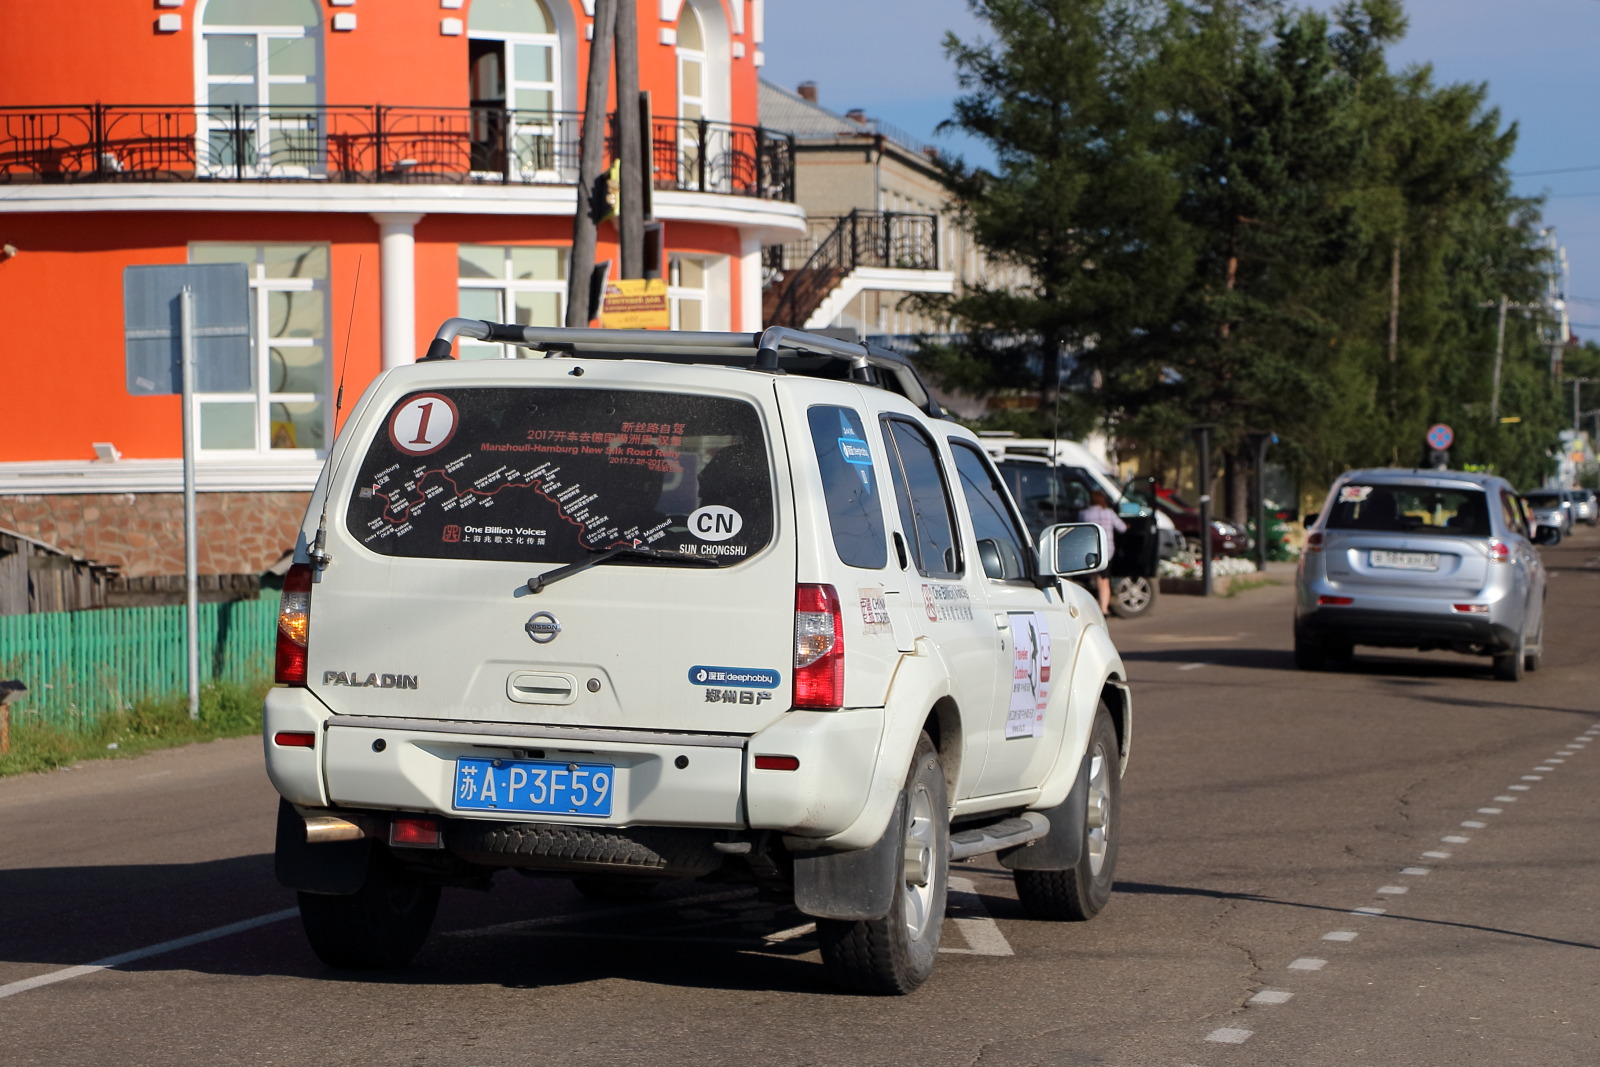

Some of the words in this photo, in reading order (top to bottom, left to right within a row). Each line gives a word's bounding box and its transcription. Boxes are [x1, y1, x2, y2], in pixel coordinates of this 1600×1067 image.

[408, 402, 433, 444] 1
[621, 421, 686, 435] 新丝路自驾
[480, 443, 579, 455] Manzhouli-Hamburg
[581, 446, 603, 454] New
[605, 447, 623, 455] Silk
[626, 447, 653, 456] Road
[655, 449, 679, 459] Rally
[374, 463, 400, 480] Hamburg
[464, 525, 483, 533] One
[484, 526, 513, 535] Billion
[515, 527, 547, 536] Voices
[643, 518, 673, 537] Manzhouli
[697, 513, 733, 533] CN
[679, 543, 697, 554] SUN
[701, 544, 747, 556] CHONGSHU
[322, 670, 418, 690] PALADIN
[727, 673, 773, 684] deephobby
[704, 688, 772, 705] 郑州日产
